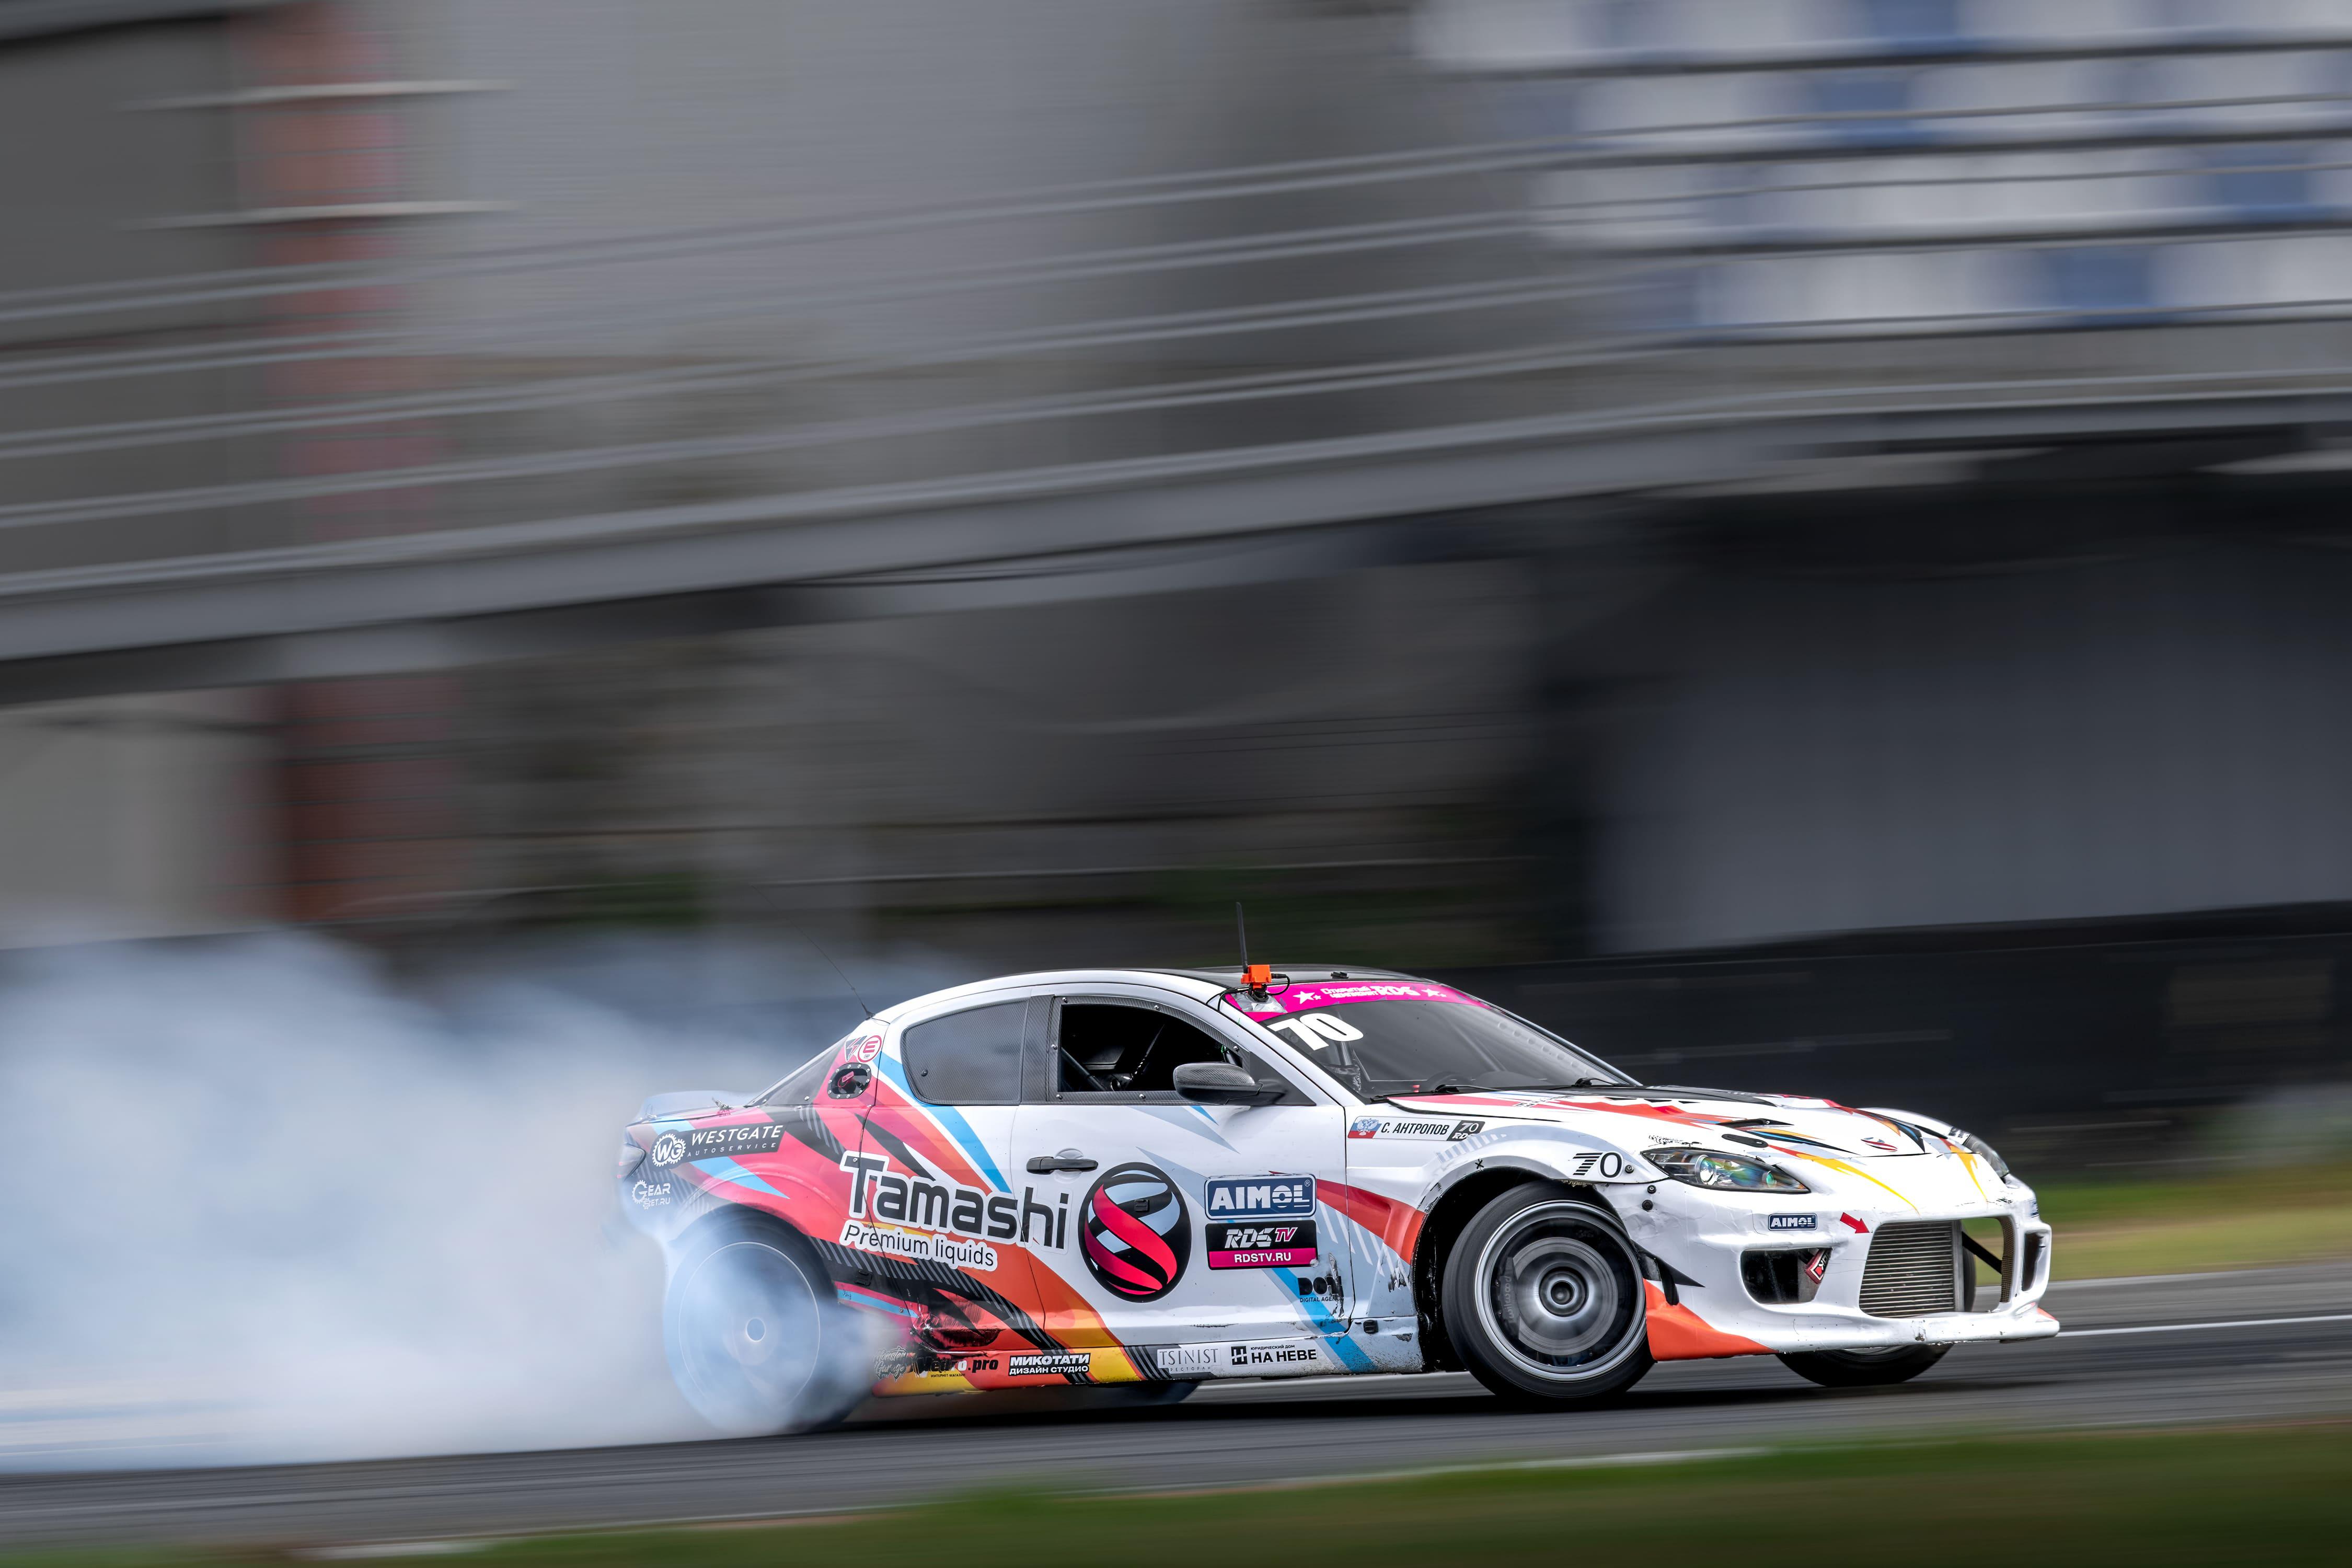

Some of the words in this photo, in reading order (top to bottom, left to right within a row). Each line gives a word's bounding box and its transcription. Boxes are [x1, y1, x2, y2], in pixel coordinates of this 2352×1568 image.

[1267, 1013, 1364, 1051] 70
[691, 1125, 783, 1146] WESTGATE
[1392, 1123, 1450, 1135] АНТРОПОВ
[1459, 1122, 1479, 1133] 70
[687, 1143, 776, 1158] AUTOSERVICE
[1573, 1152, 1622, 1178] 70
[632, 1179, 671, 1205] GEAR
[1210, 1185, 1310, 1210] AIMOL
[844, 1155, 1069, 1250] Tamashi
[1771, 1217, 1815, 1227] AIMOL
[845, 1224, 929, 1255] Premium
[936, 1240, 994, 1266] liquids
[1234, 1252, 1292, 1263] RDSTV.RU
[1010, 1354, 1090, 1366] МИКОТАТИ
[1159, 1348, 1219, 1366] TSINIST
[1251, 1351, 1274, 1364] НА
[1276, 1349, 1318, 1362] НЕВЕ
[1009, 1366, 1049, 1376] ДИЗАЙН
[1050, 1365, 1089, 1374] СТУДИО
